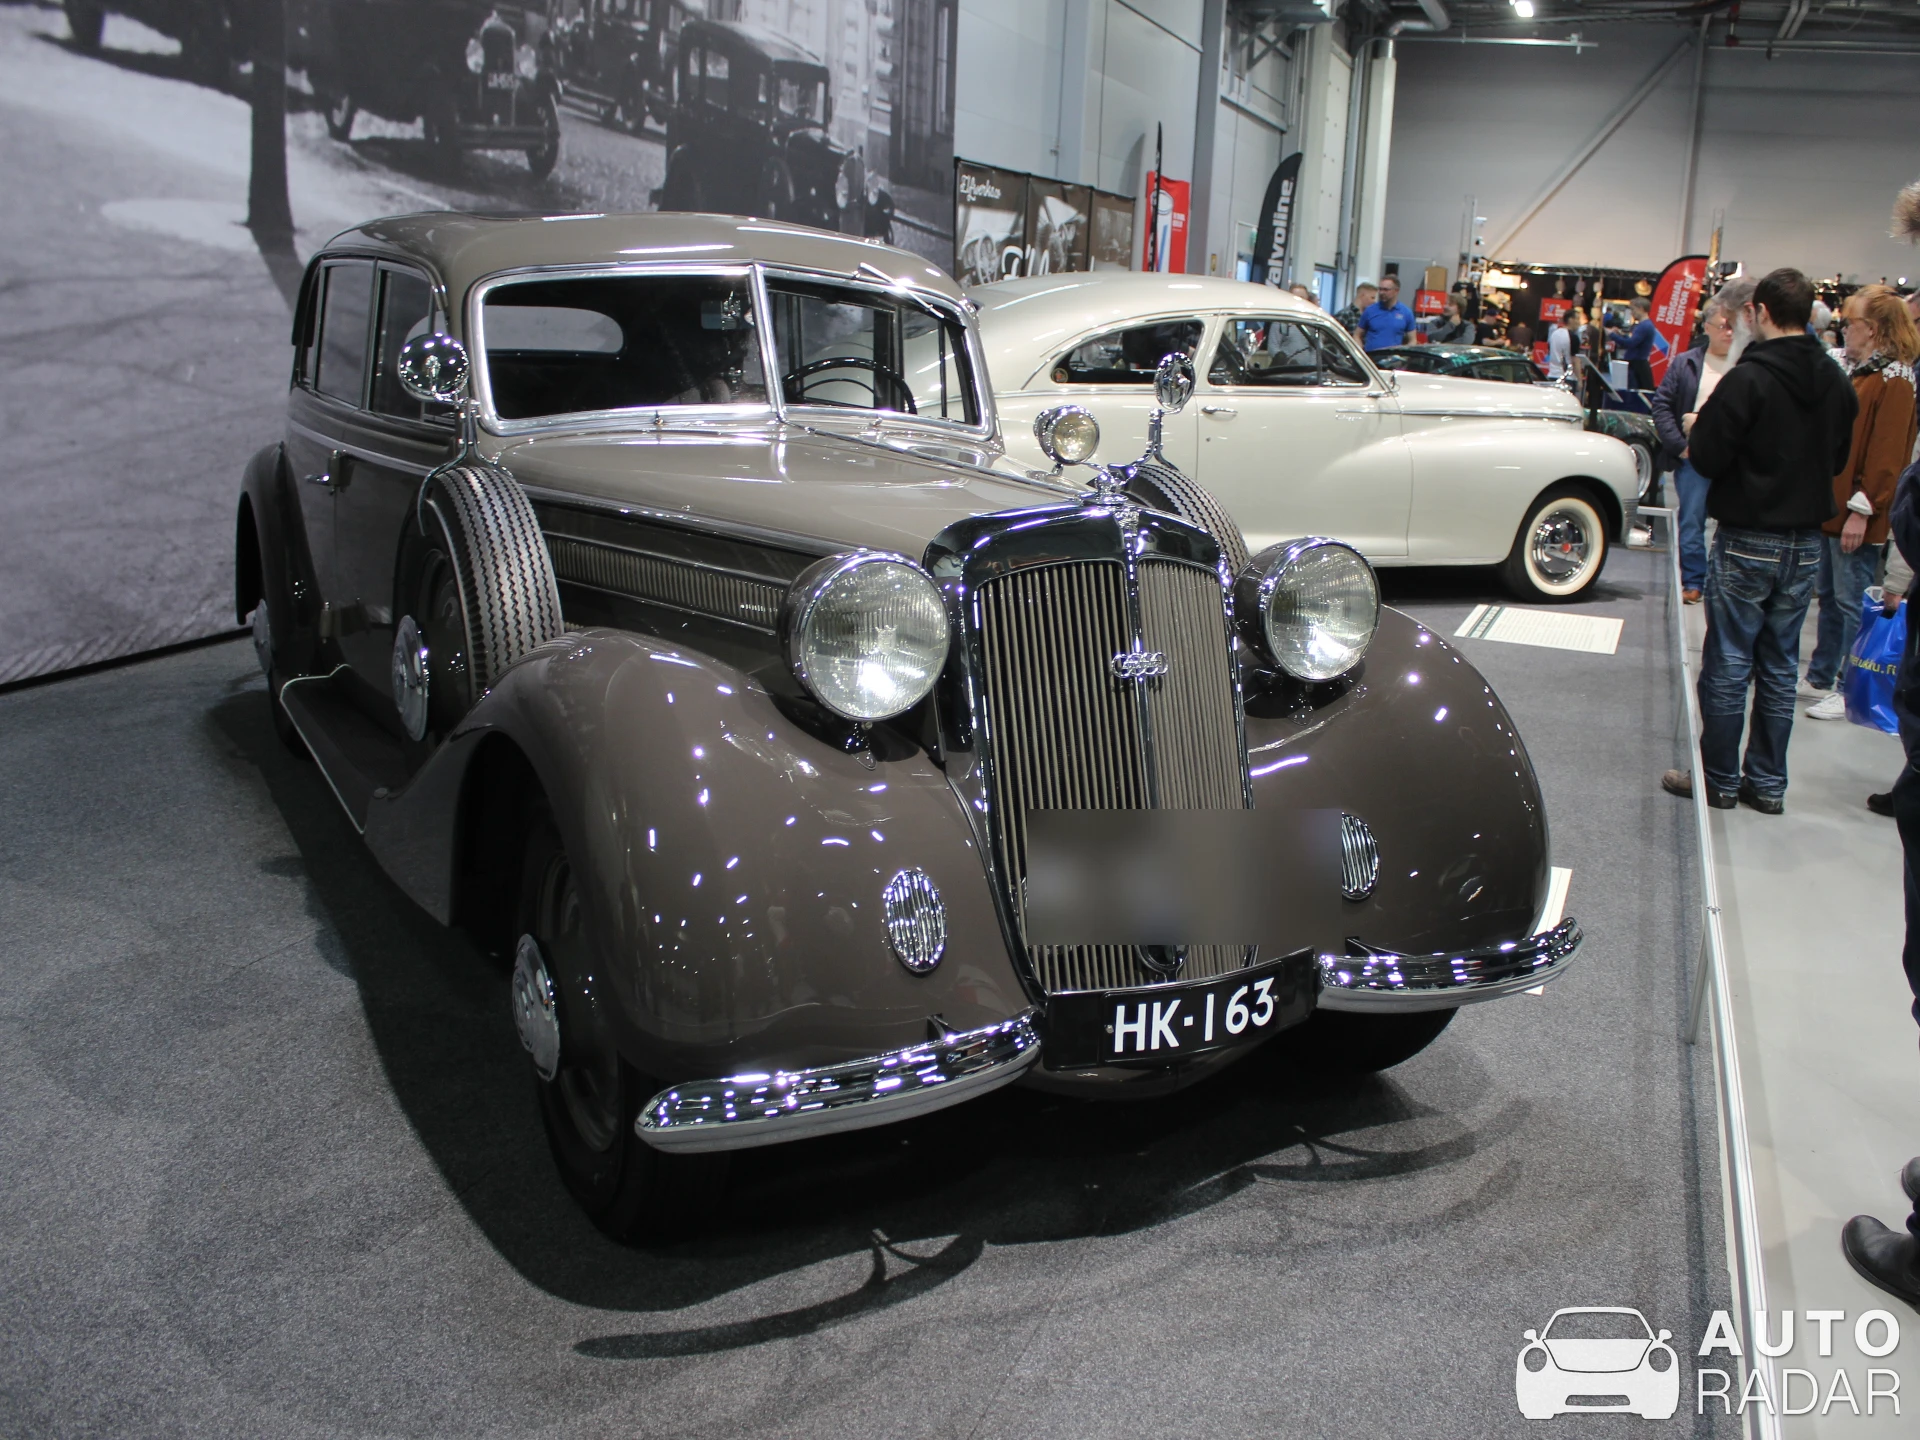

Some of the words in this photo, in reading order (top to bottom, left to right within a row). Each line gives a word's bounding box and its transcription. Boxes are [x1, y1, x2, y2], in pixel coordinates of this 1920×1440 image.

[1656, 305, 1668, 322] THE
[1665, 280, 1684, 325] ORIGINAL
[1673, 291, 1690, 326] MOTOR
[1114, 977, 1275, 1053] HK-163
